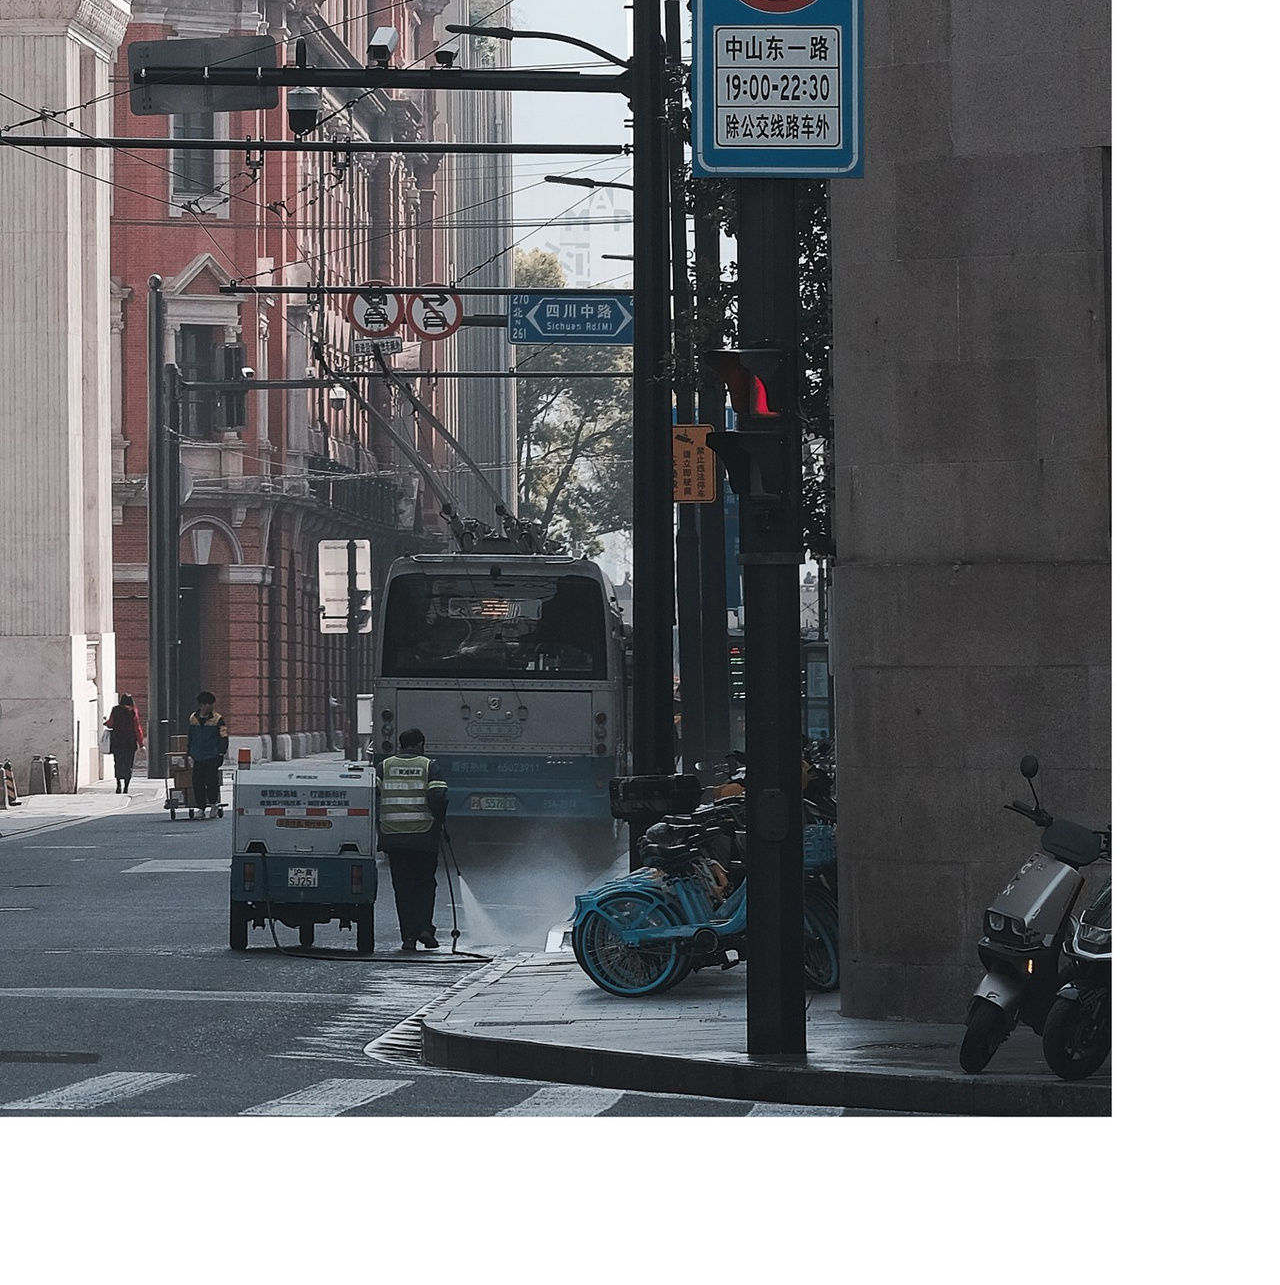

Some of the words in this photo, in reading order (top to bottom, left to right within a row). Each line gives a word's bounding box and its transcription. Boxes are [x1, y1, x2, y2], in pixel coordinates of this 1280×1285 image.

[725, 35, 829, 61] 中山东一路
[725, 74, 830, 102] 19:00-22:30
[725, 113, 830, 141] 除公交线路车外
[513, 307, 523, 318] 北
[546, 303, 613, 319] 四川中路
[512, 328, 527, 339] 261
[546, 321, 582, 331] Sichuan
